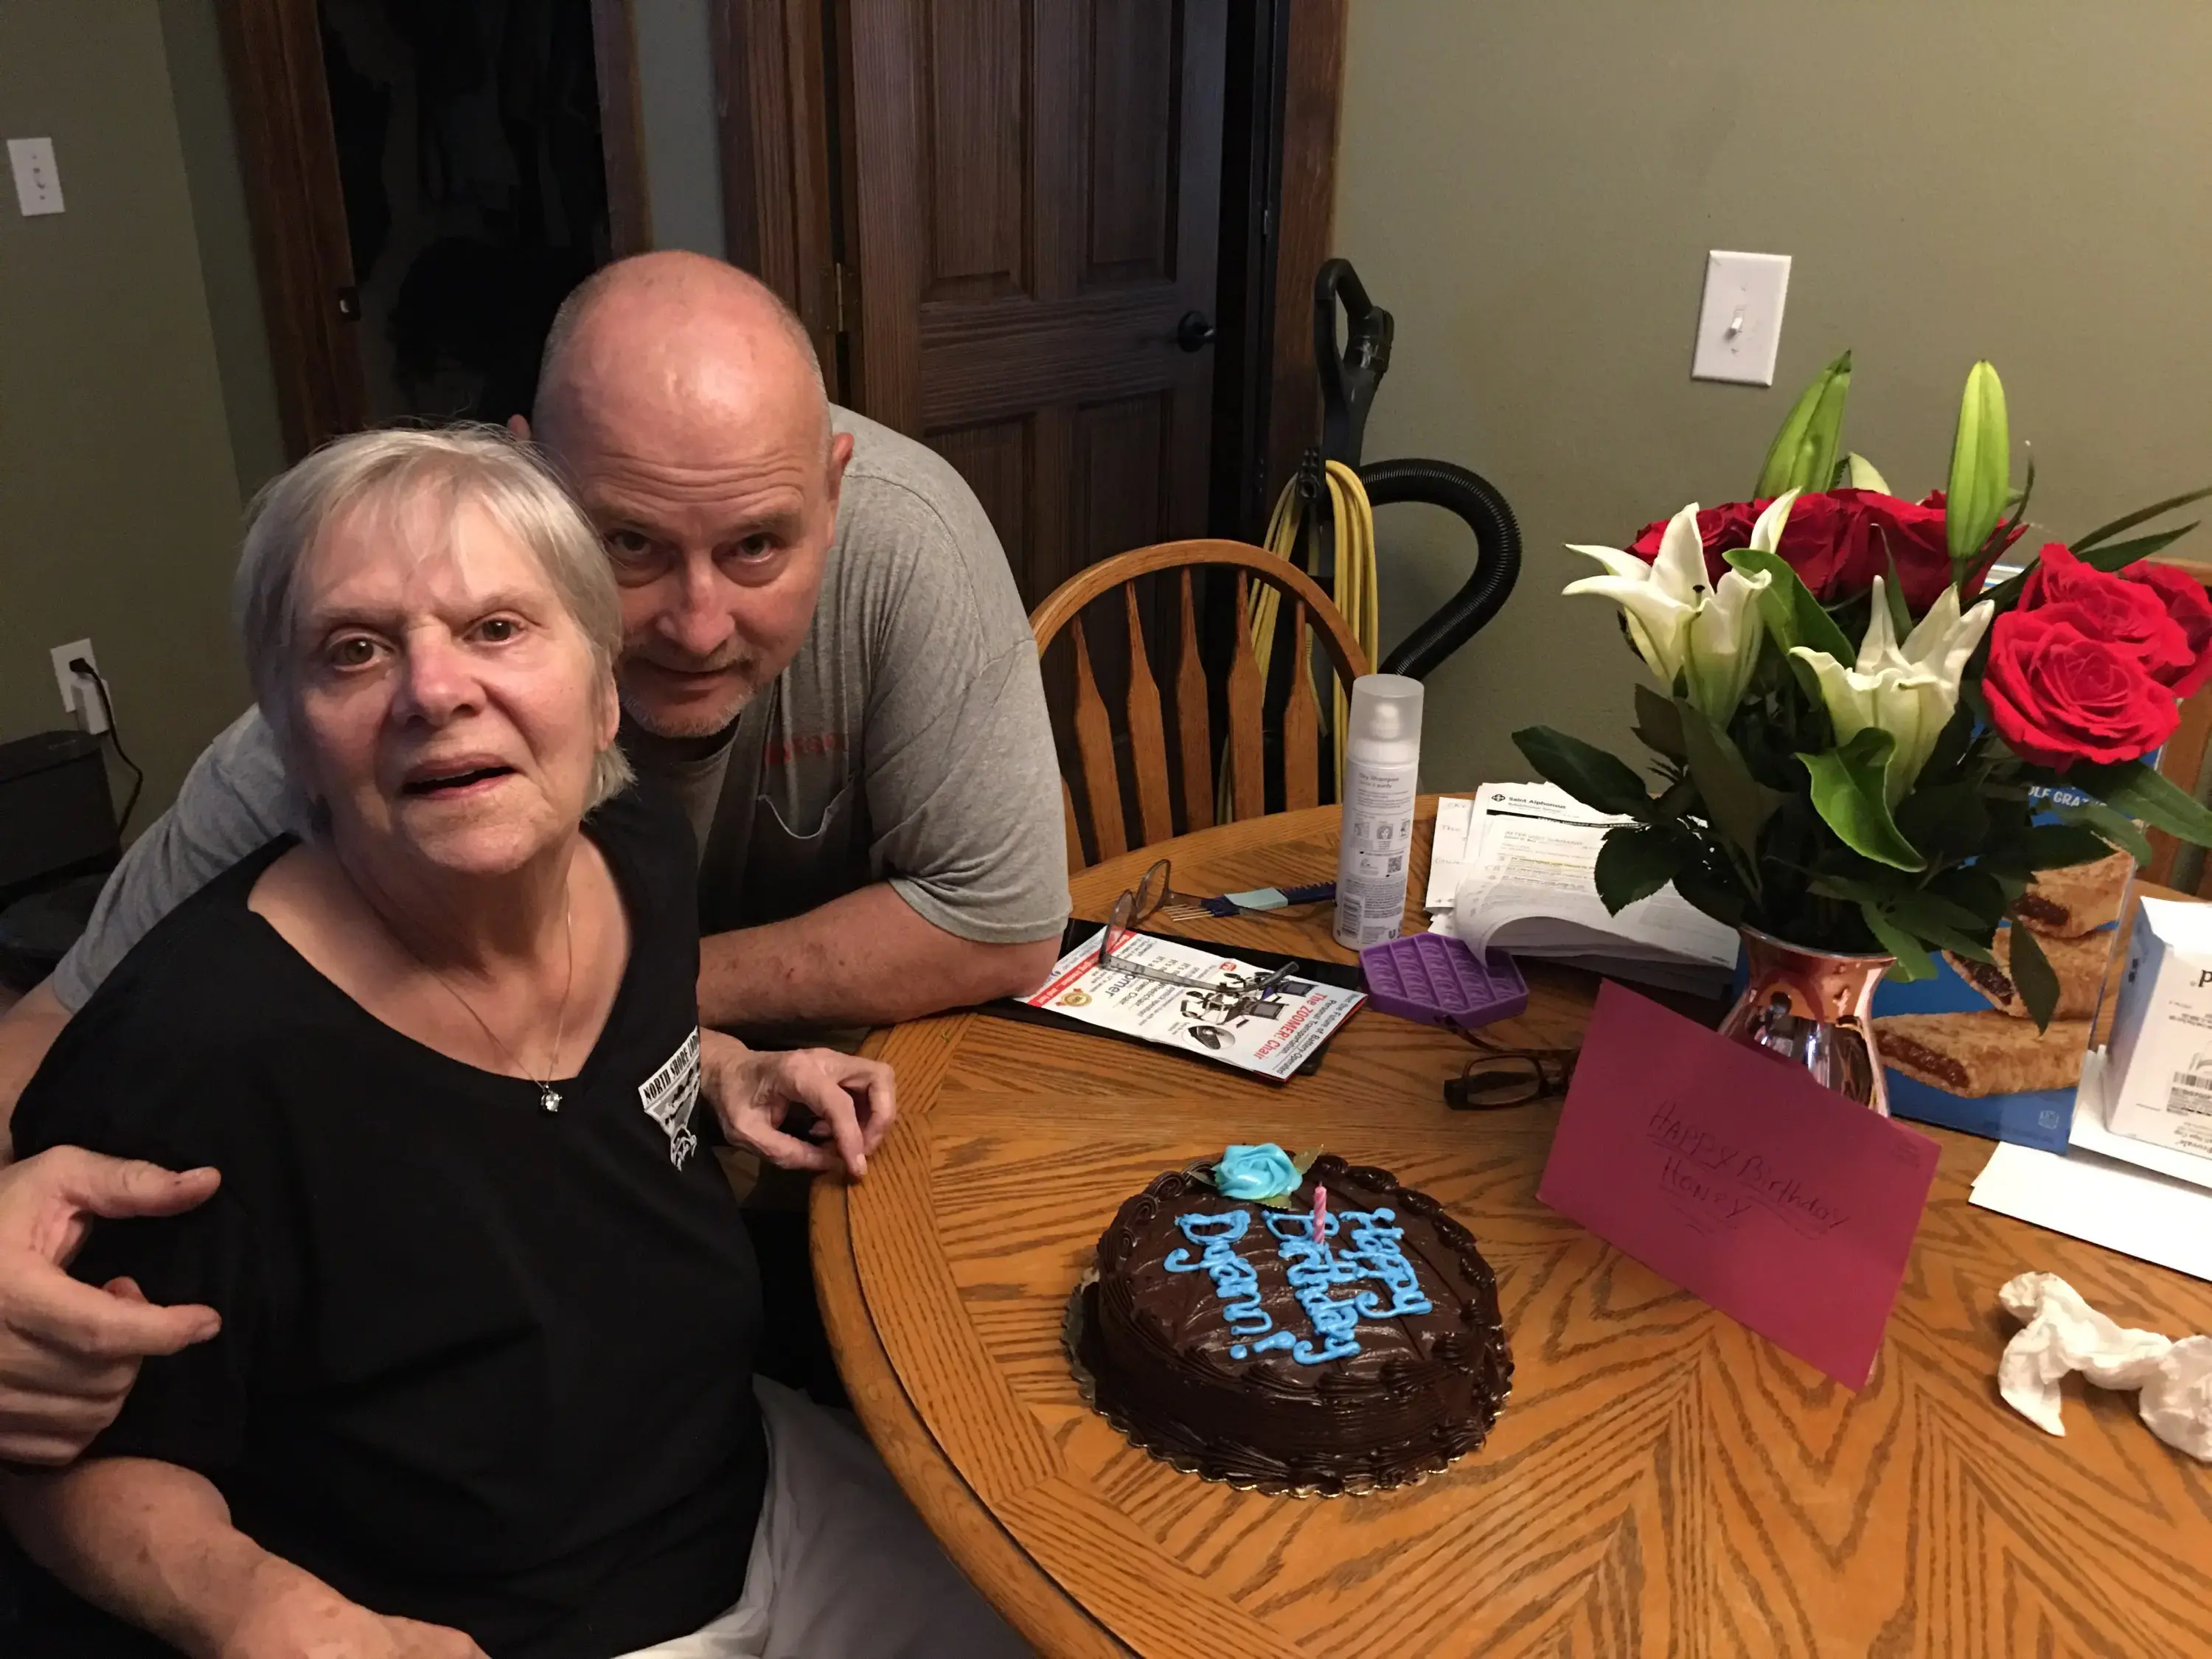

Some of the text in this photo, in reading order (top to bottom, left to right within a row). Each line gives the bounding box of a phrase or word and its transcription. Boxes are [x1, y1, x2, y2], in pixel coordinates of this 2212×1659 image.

[1528, 799, 1567, 810] Alphonsus
[2053, 790, 2100, 808] GRA
[1312, 999, 1338, 1020] Personal
[1335, 1003, 1349, 1012] the
[1253, 992, 1328, 1060] The ZOOMER! Chair
[1315, 1026, 1324, 1034] of
[1321, 1011, 1341, 1028] Future
[1276, 1034, 1320, 1074] Battery-Operated
[643, 1068, 671, 1102] NORTH
[669, 1046, 689, 1077] SHORE
[1339, 1207, 1433, 1318] Happy
[1261, 1210, 1361, 1366] Birthday
